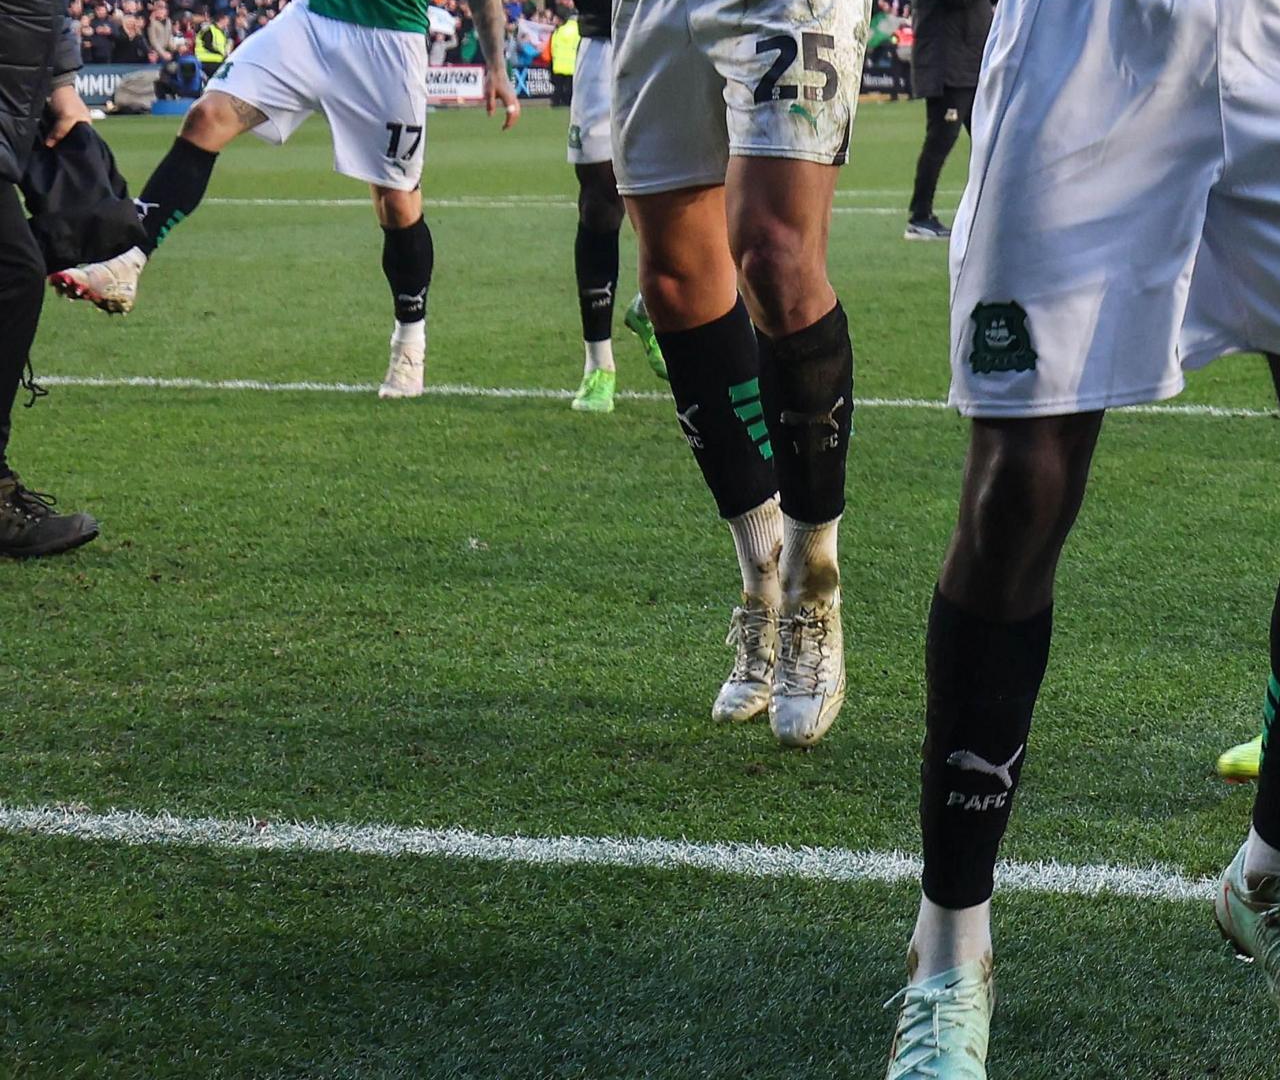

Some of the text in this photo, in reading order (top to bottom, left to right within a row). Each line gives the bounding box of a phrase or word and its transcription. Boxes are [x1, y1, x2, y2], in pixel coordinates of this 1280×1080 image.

[753, 31, 838, 105] 25
[386, 122, 422, 161] 17
[946, 790, 1009, 811] PAFC
